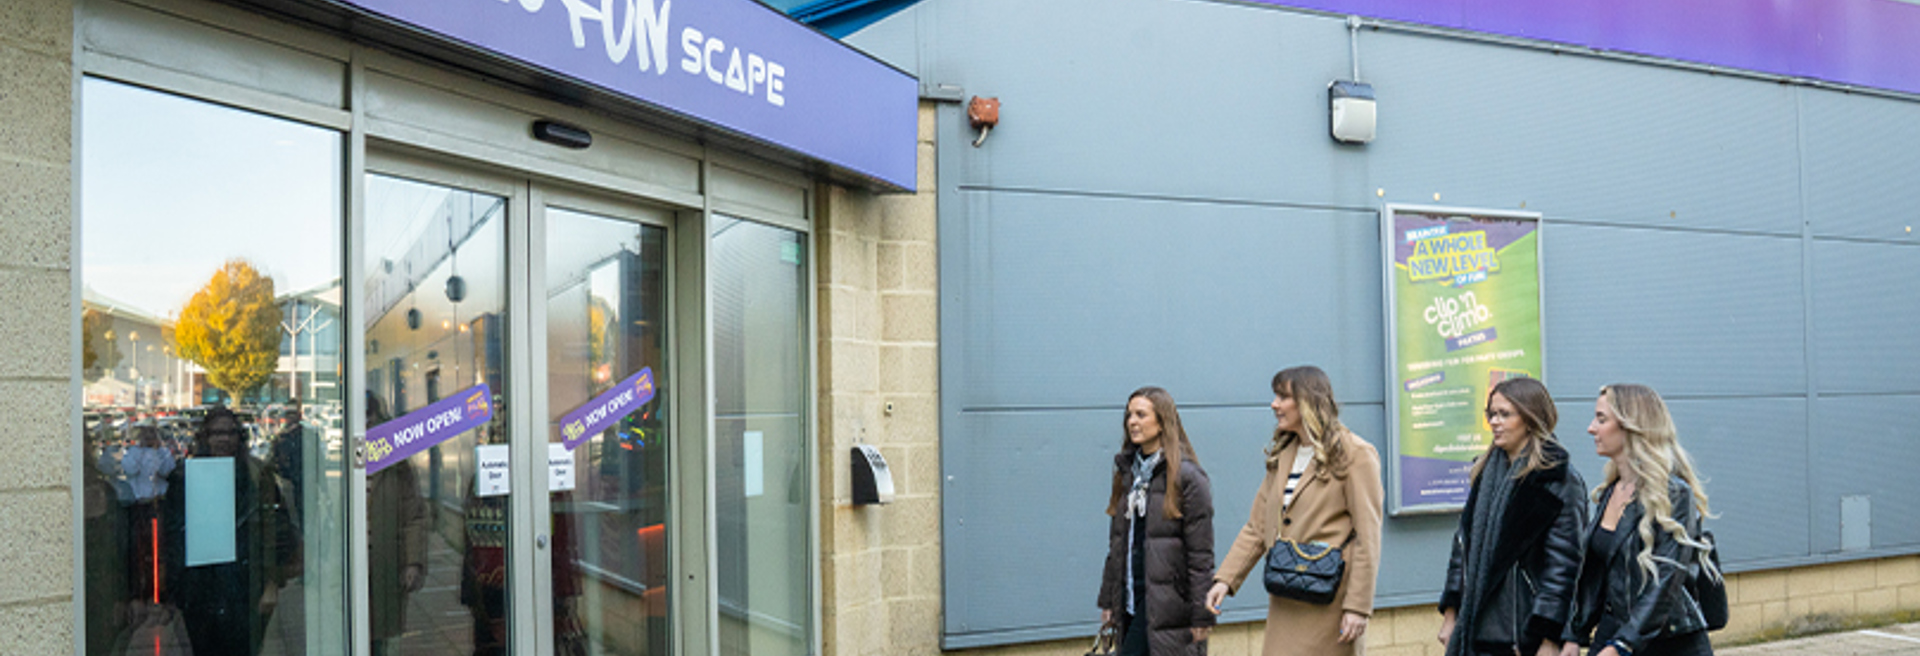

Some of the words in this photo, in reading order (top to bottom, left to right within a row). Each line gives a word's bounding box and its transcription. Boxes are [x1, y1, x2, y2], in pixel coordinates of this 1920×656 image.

[562, 0, 671, 75] FUN
[681, 27, 785, 106] SCAPE
[1417, 241, 1429, 257] A
[1430, 233, 1484, 256] WHOLE
[1411, 257, 1448, 277] NEW
[1451, 251, 1498, 272] LEVEL
[1424, 296, 1459, 324] clip
[394, 422, 424, 448] NOW
[426, 406, 462, 434] OPEN!
[585, 404, 607, 428] NOW
